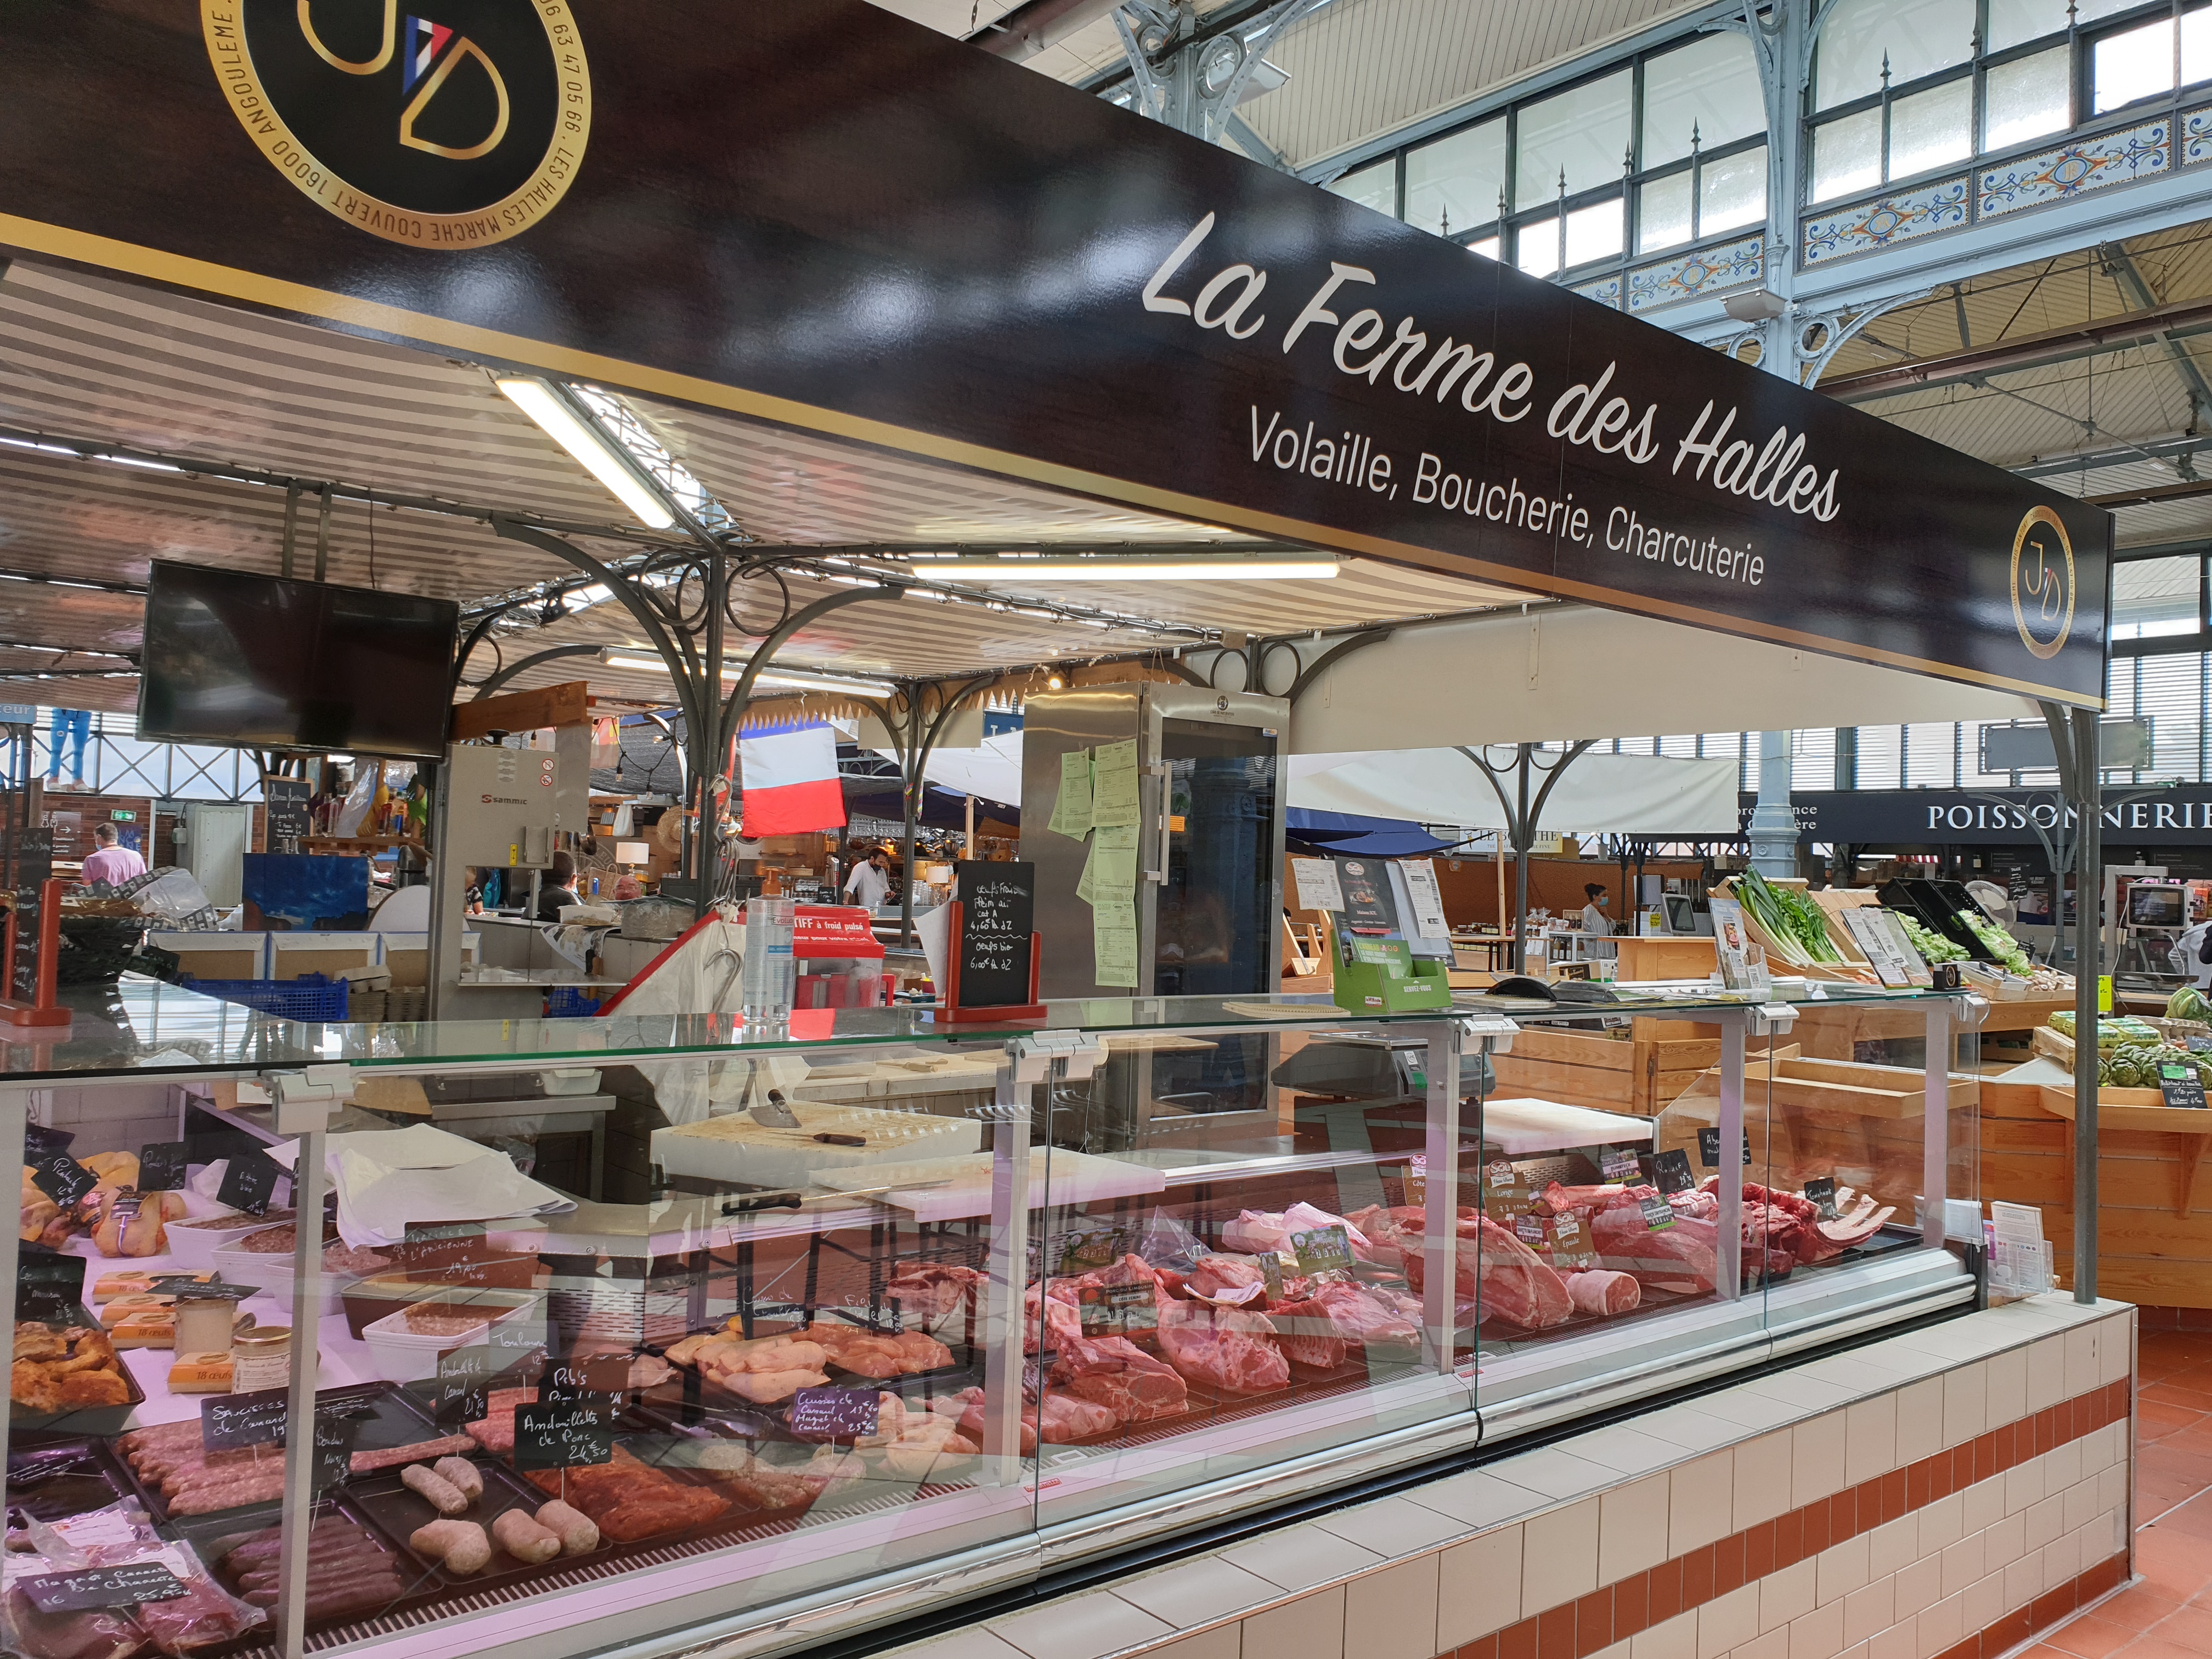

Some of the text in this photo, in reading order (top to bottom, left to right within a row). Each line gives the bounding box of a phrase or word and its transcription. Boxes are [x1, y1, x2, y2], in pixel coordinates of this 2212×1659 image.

[554, 24, 574, 46] 63
[212, 10, 277, 134] ANGOULEME
[563, 54, 580, 75] 47
[566, 82, 583, 105] 05
[565, 110, 582, 132] 66
[272, 140, 329, 195] 16000
[550, 147, 576, 180] LES
[503, 177, 557, 225] HALLES
[331, 190, 422, 239] COUVERT
[432, 220, 500, 242] MARCHE
[1142, 211, 1841, 522] La Ferme des Halles
[1250, 404, 1765, 585] Volaille, Boucherie, Charcuterie
[493, 795, 527, 805] sammic
[817, 921, 822, 929] à
[844, 922, 864, 931] pulsé
[1497, 1186, 1514, 1197] Longe
[197, 1371, 207, 1380] 18
